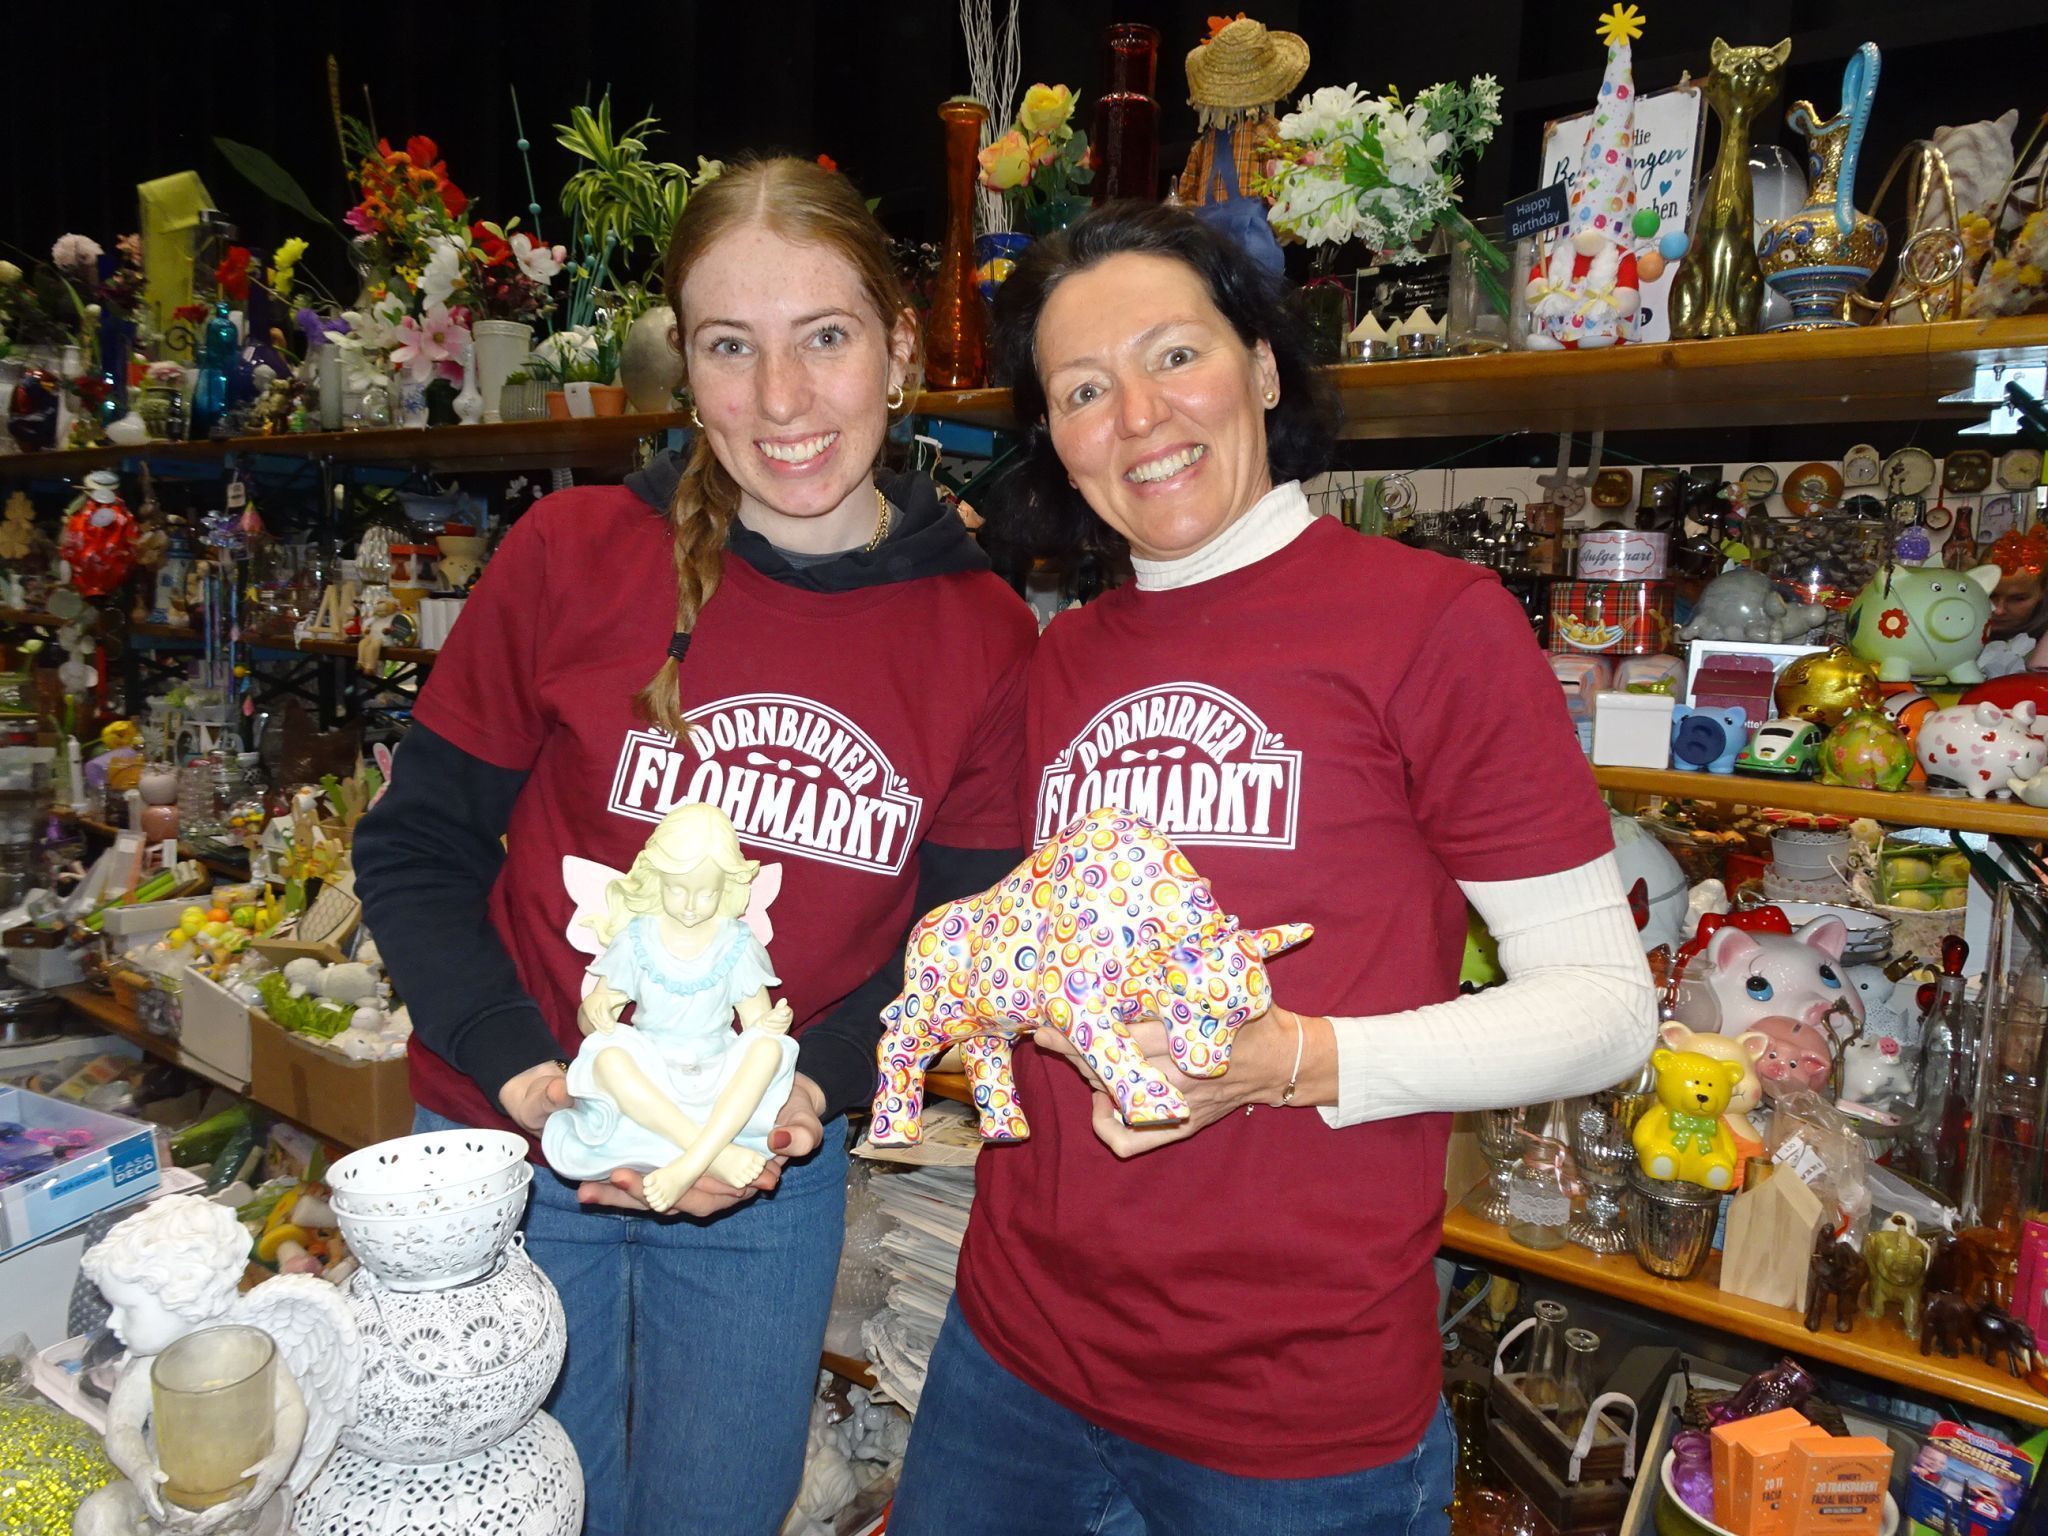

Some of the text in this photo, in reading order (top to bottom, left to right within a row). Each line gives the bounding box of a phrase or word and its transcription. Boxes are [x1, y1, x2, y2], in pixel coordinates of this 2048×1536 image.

[1516, 196, 1551, 217] Happy
[1511, 209, 1560, 236] Birthday
[1077, 695, 1247, 774] DORNBIRNER
[687, 705, 878, 796] DORNBIRNER
[624, 745, 906, 863] FLOHMARKT
[1041, 762, 1284, 838] FLOHMARKT
[114, 1153, 153, 1174] CASA
[115, 1161, 154, 1183] DECO
[1949, 1437, 2013, 1471] SCHIFFE
[1765, 1478, 1775, 1490] 20
[1815, 1481, 1879, 1493] 20 TRANSPARENT
[1812, 1494, 1834, 1505] FACIAL
